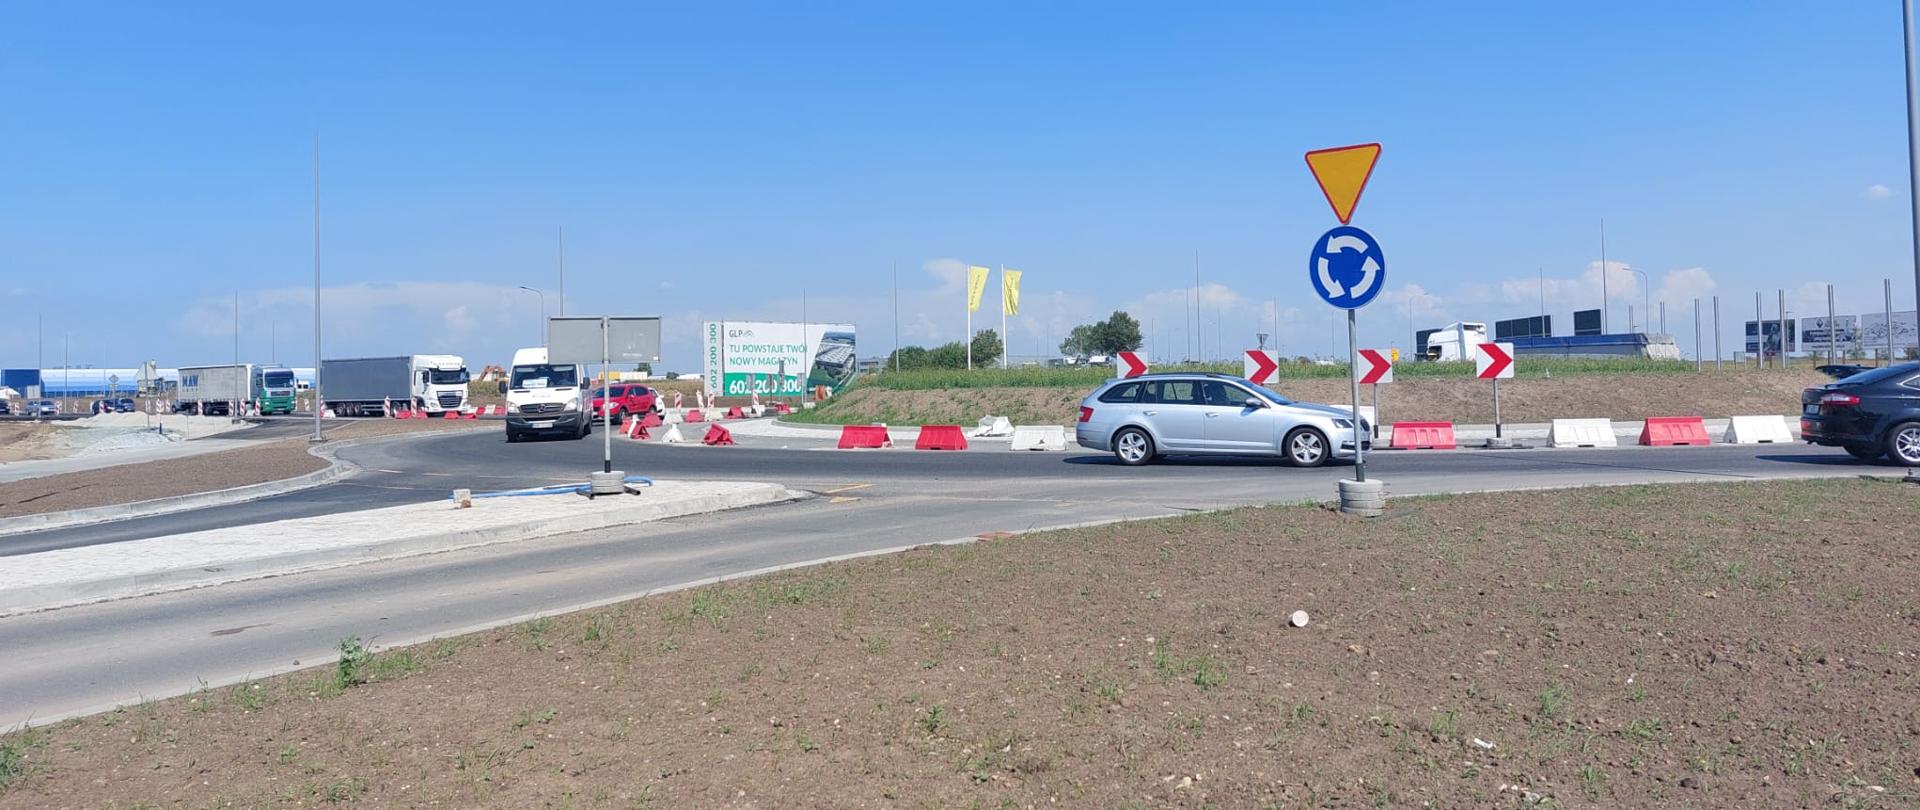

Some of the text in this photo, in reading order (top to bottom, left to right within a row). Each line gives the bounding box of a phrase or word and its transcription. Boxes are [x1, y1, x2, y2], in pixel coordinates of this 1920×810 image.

[729, 329, 743, 338] GLP
[729, 344, 740, 353] TU
[742, 344, 785, 353] POWSTAJE
[709, 323, 718, 389] 602 200 300
[729, 356, 756, 365] NOWY
